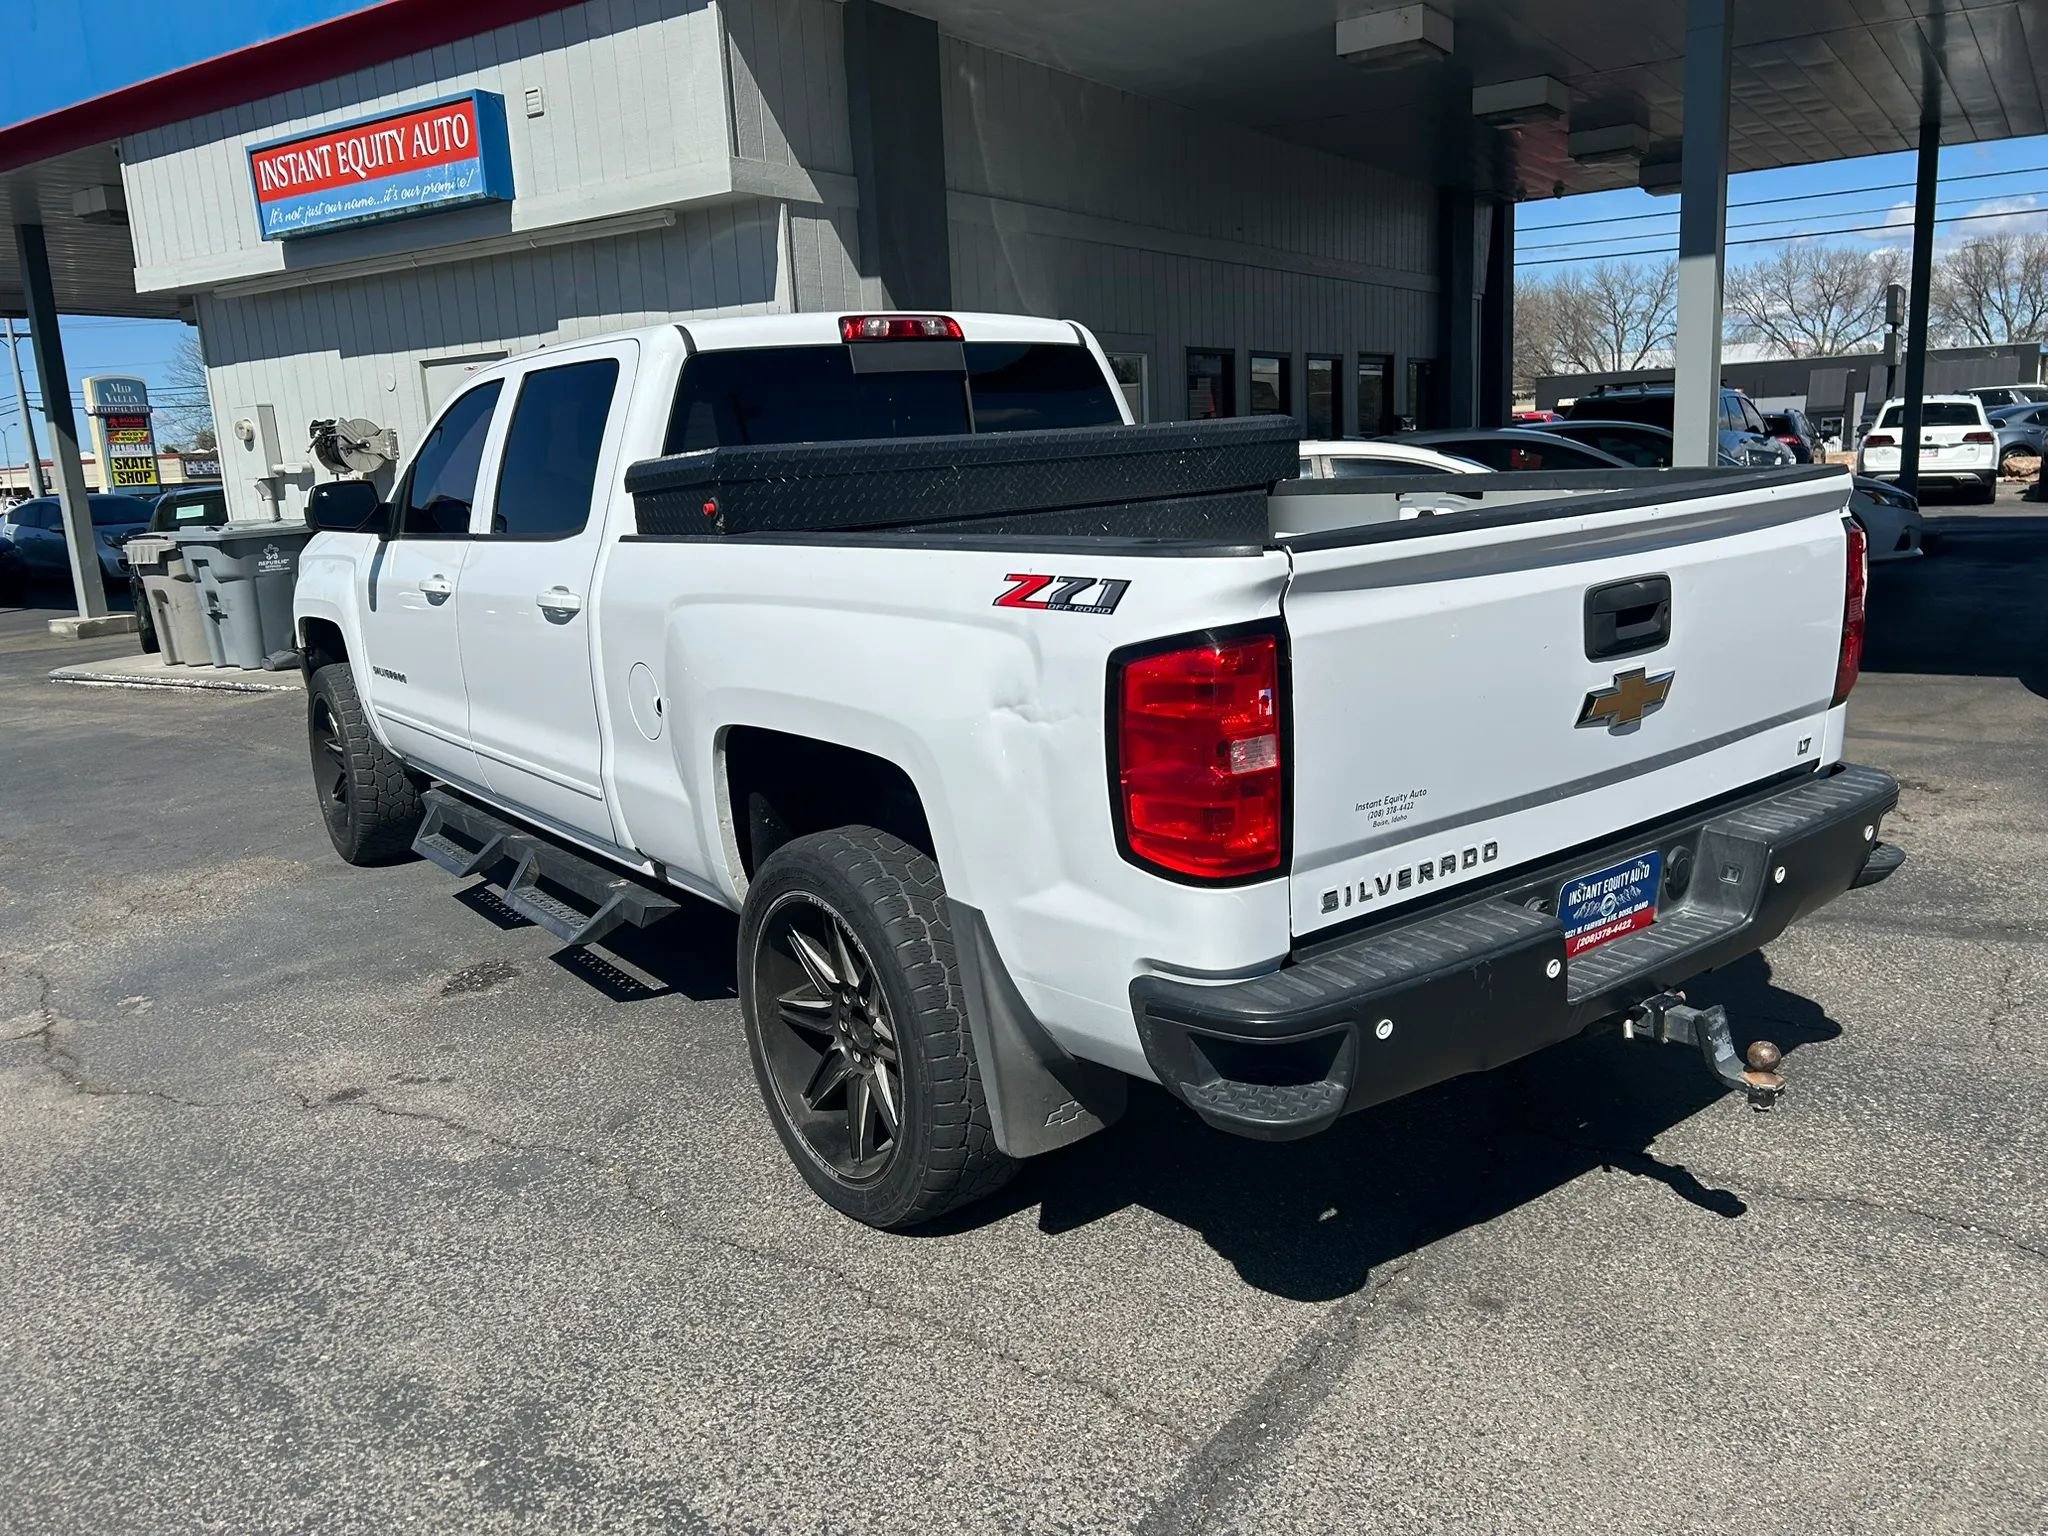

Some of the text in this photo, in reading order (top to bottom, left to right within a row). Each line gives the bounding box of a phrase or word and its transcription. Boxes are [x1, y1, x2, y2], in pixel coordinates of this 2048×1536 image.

[259, 113, 470, 191] INSTANT EQUITY AUTO
[269, 208, 283, 226] It's
[285, 206, 303, 220] not
[301, 202, 325, 225] just
[324, 201, 342, 214] our
[400, 185, 421, 200] our
[114, 457, 153, 470] SKATE
[118, 471, 151, 484] SHOP
[992, 573, 1132, 611] Z71
[1047, 603, 1112, 614] OFF ROAD
[1797, 737, 1812, 756] LT
[1355, 789, 1428, 812] Instant Equity Auto
[1367, 802, 1414, 821] (208) 378-4422
[1390, 814, 1408, 824] Idaho
[1320, 840, 1498, 914] SILVERADO
[1568, 861, 1650, 907] INSTANT EQUITY AUTO
[1583, 917, 1608, 932] FAIRVIEW
[1633, 900, 1649, 912] IDAHO
